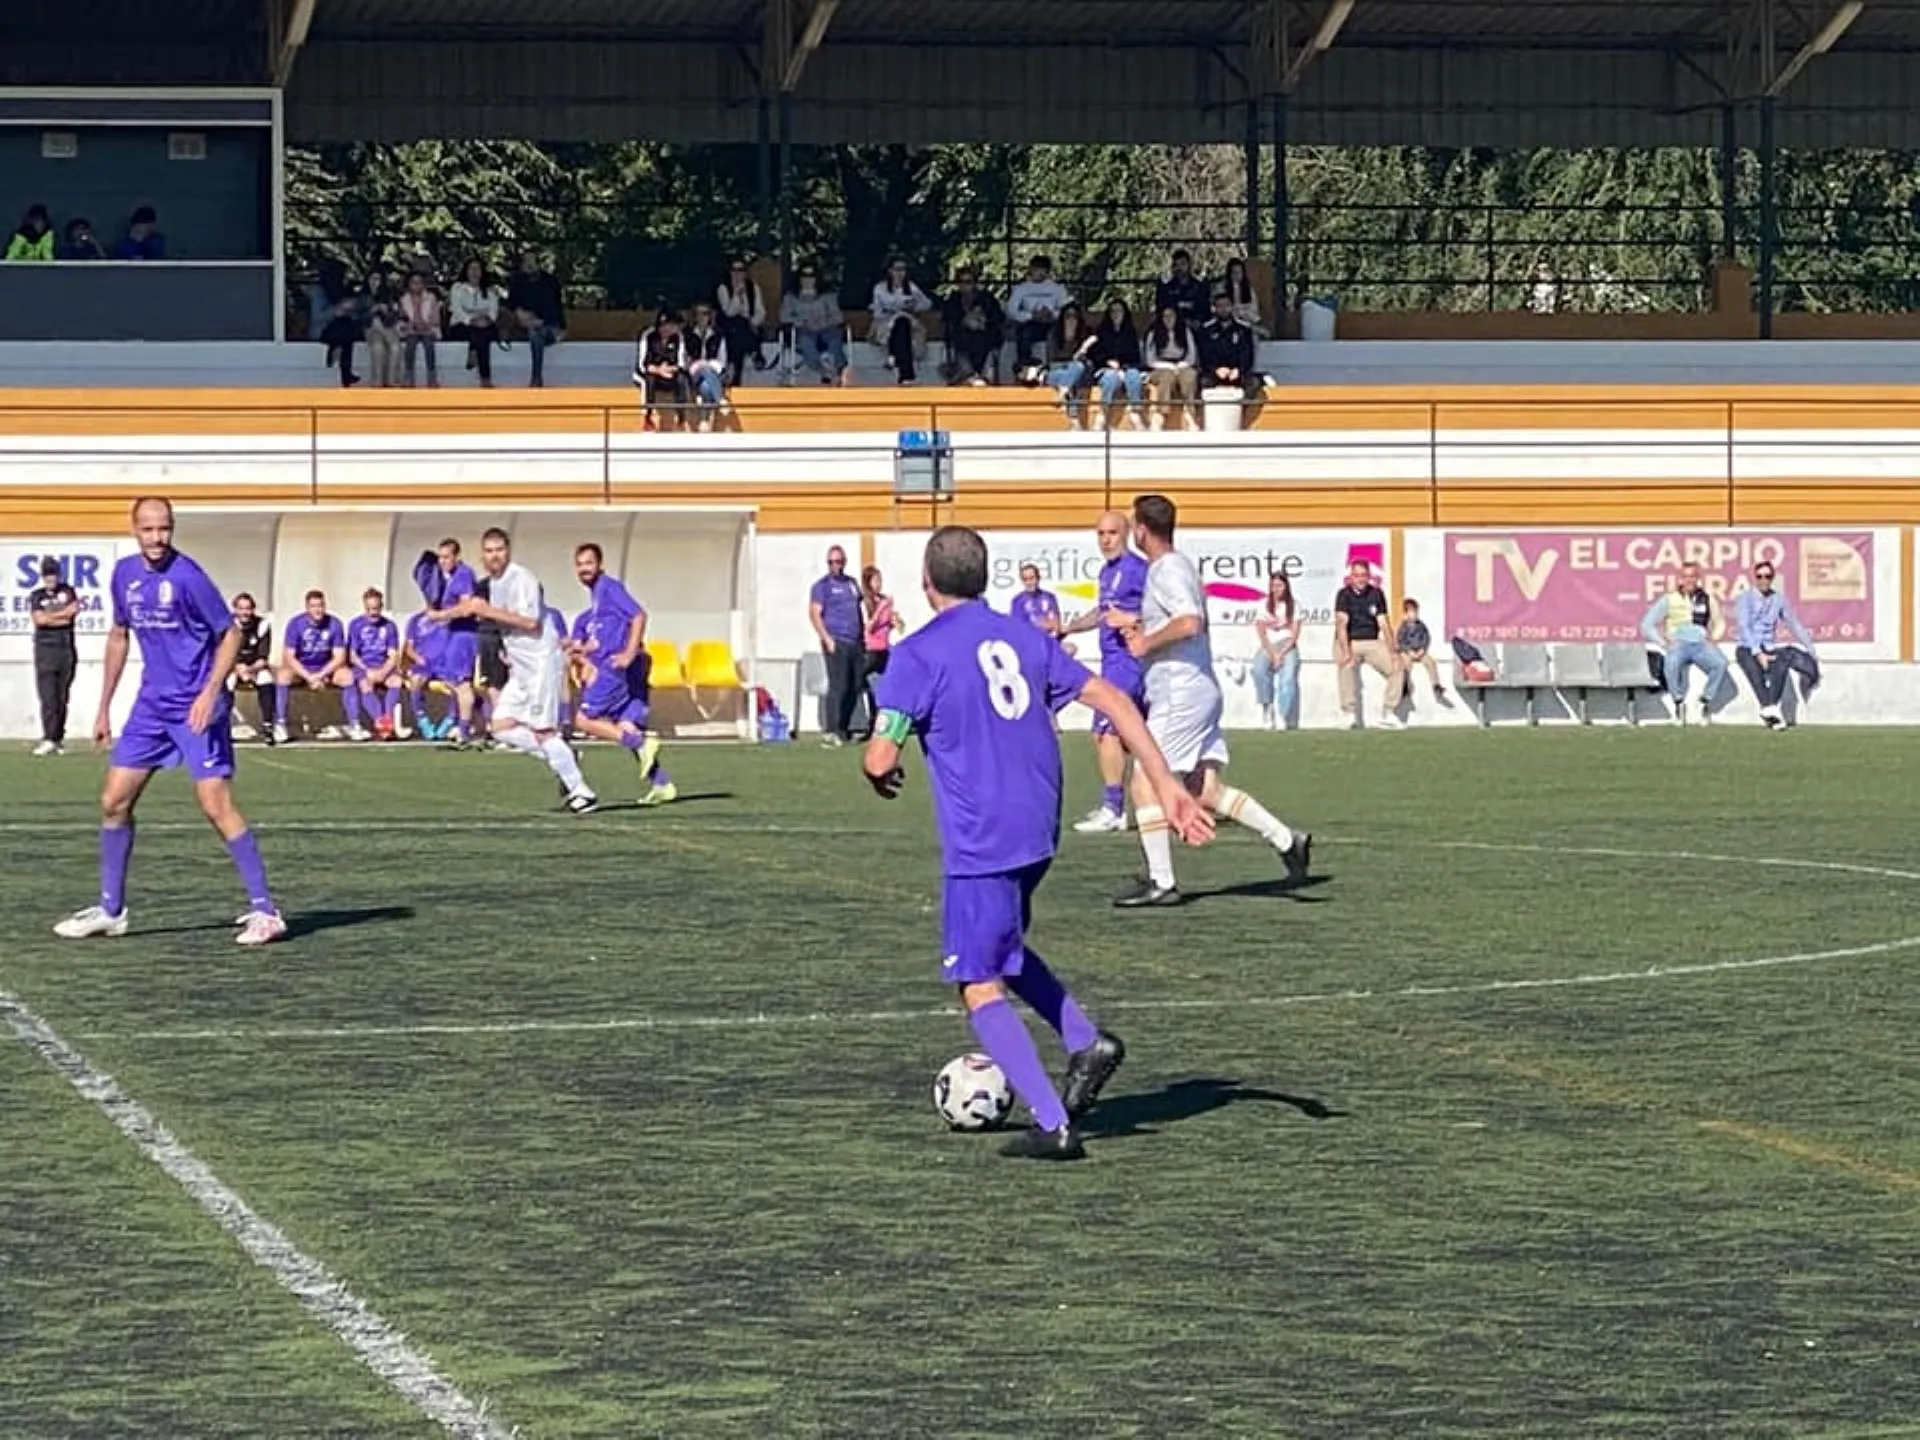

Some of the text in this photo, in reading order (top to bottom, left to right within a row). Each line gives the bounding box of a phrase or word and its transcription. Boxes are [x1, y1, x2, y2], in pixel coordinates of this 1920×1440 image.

[1455, 540, 1560, 602] TV
[1570, 538, 1620, 569] EL
[1624, 537, 1786, 570] CARPIO
[977, 640, 1031, 721] 8
